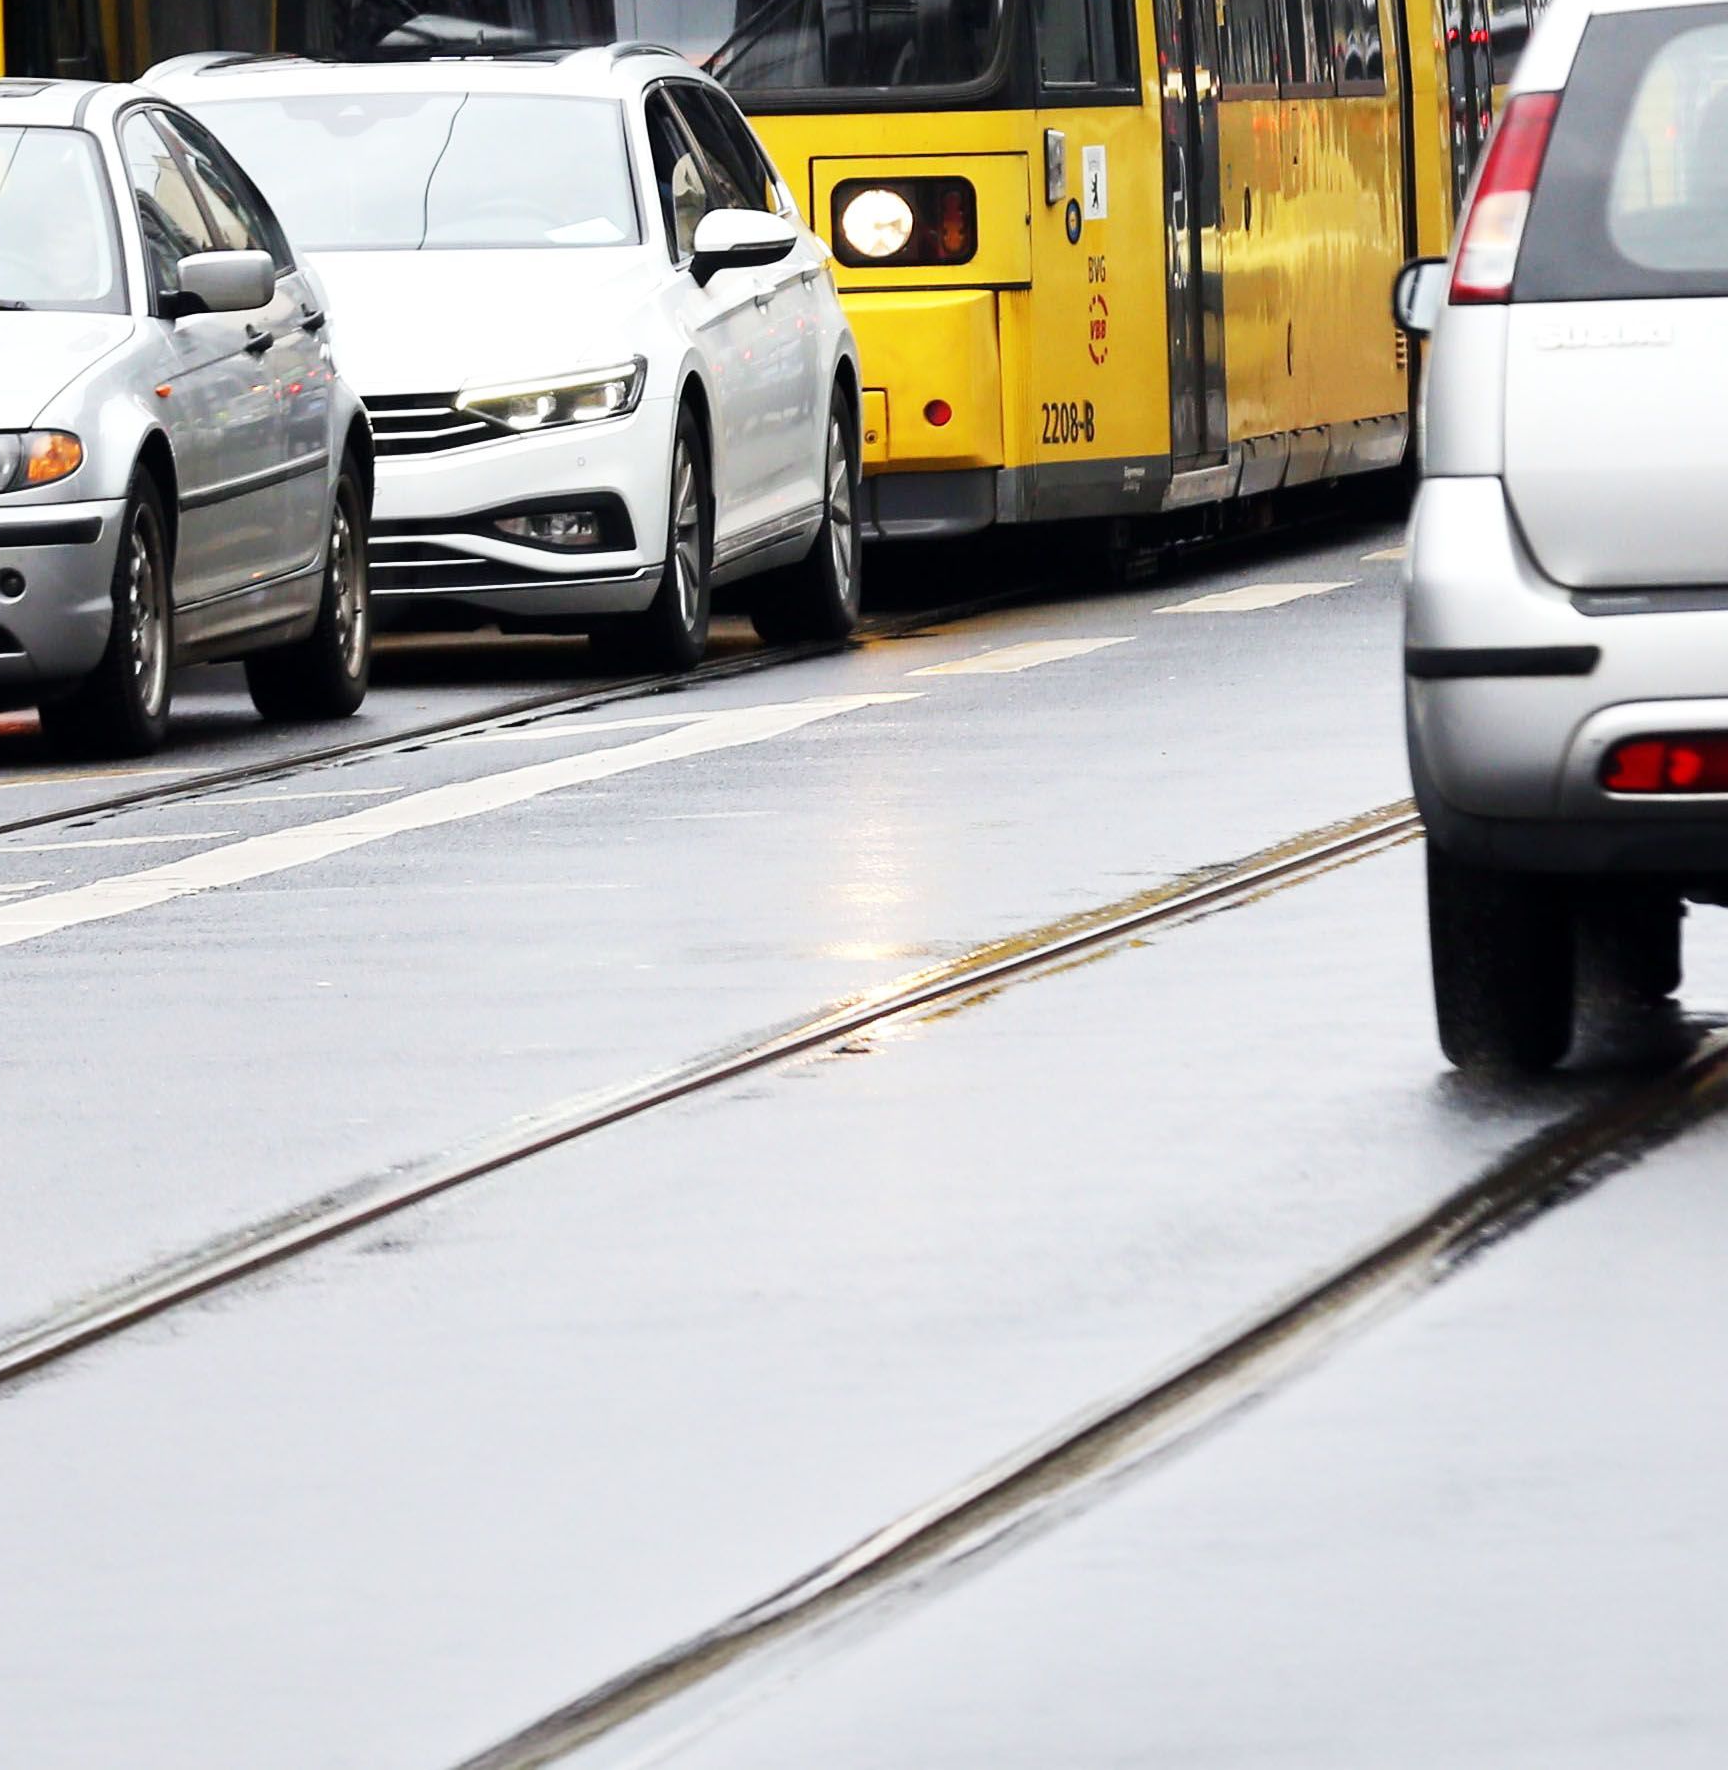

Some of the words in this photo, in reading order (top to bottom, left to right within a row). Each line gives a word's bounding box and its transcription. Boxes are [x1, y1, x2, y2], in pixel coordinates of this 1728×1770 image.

[1088, 255, 1106, 284] BVG
[1089, 319, 1107, 340] VBB
[1041, 401, 1095, 445] 2208-B
